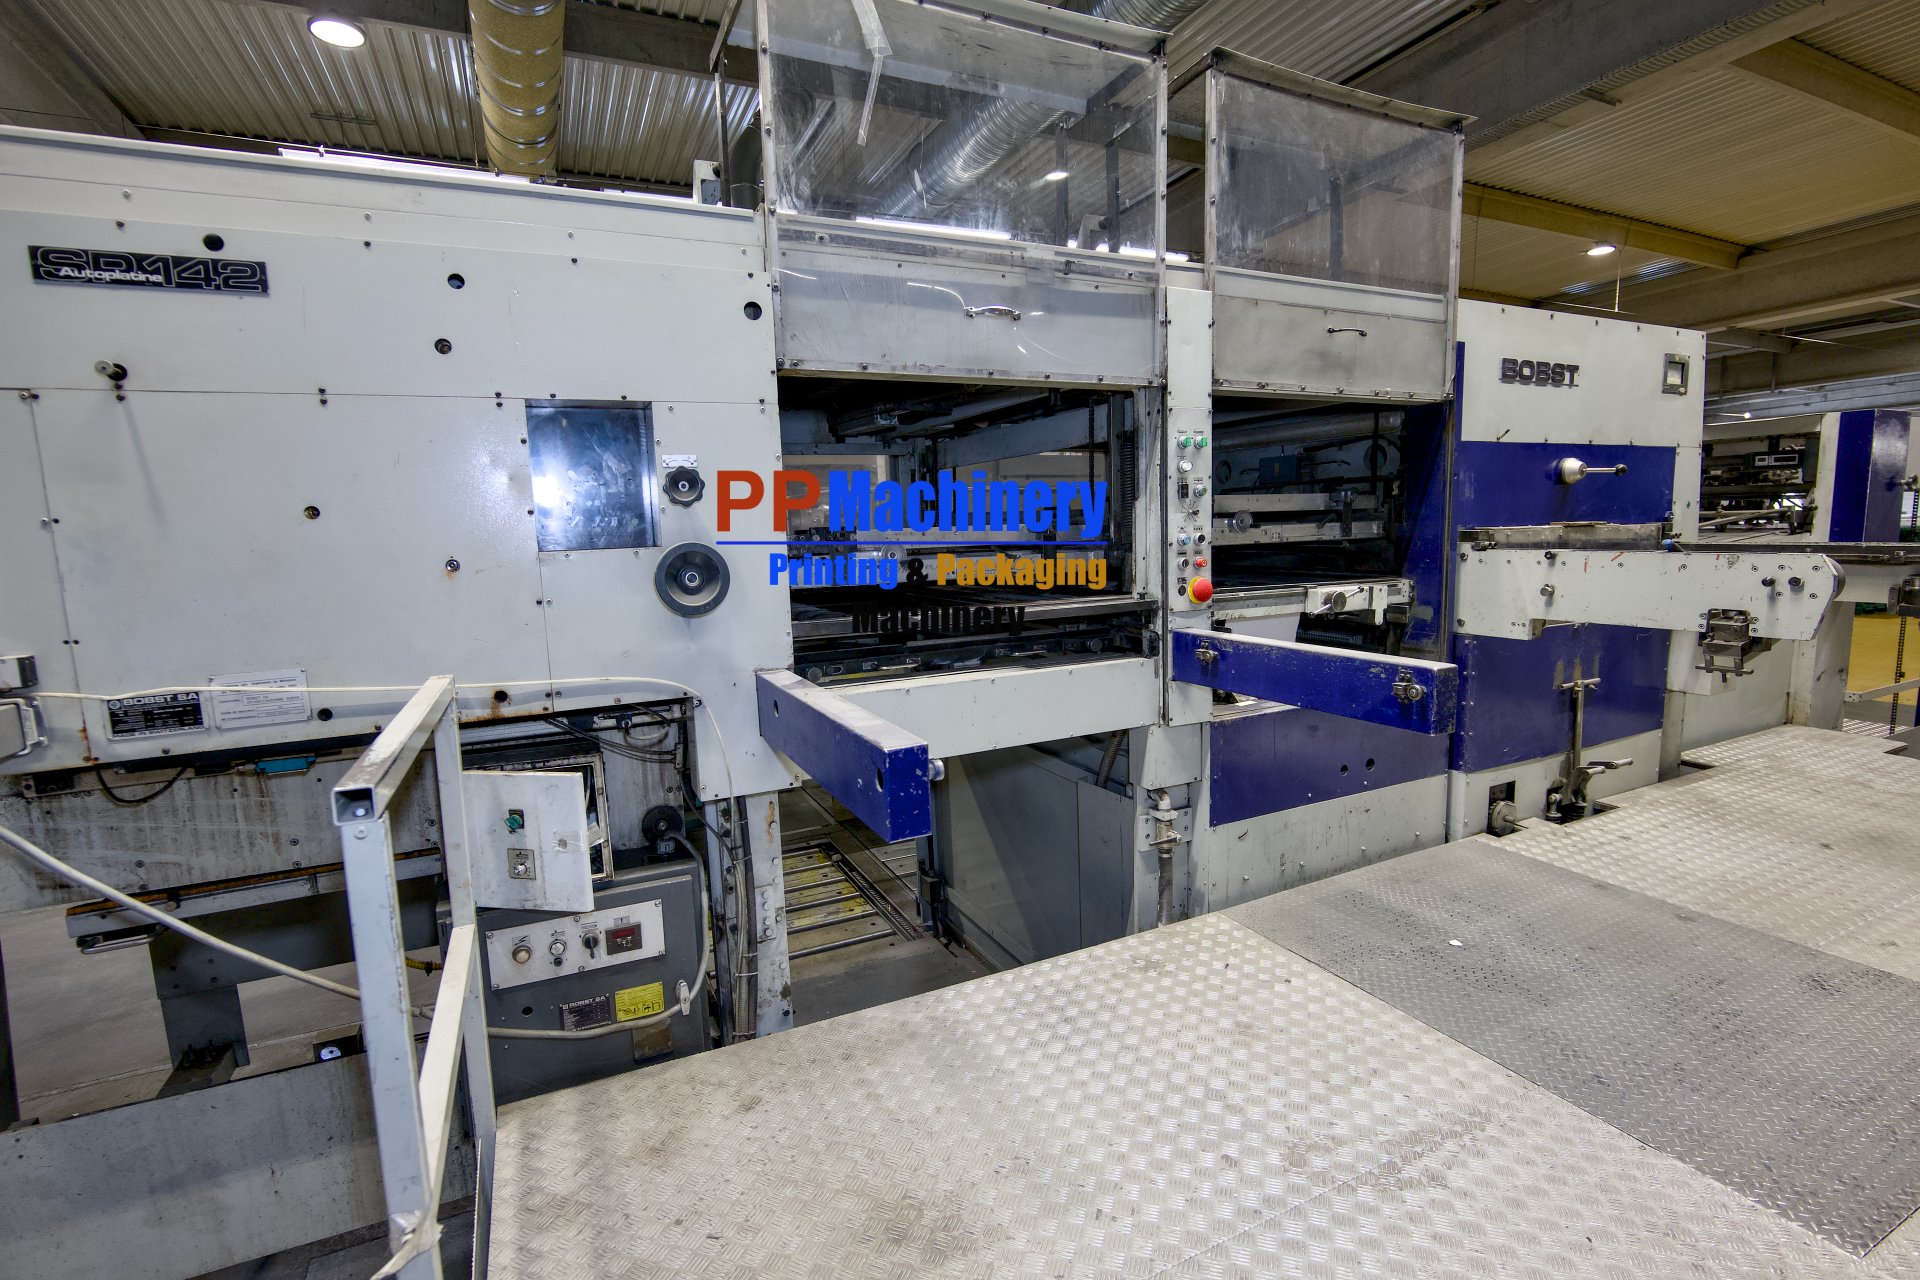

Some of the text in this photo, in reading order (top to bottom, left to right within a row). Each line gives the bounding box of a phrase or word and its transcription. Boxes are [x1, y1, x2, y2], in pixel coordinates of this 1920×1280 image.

[59, 266, 164, 284] Autoplatine
[1501, 357, 1580, 385] BOBST
[122, 692, 199, 706] BOBST SA
